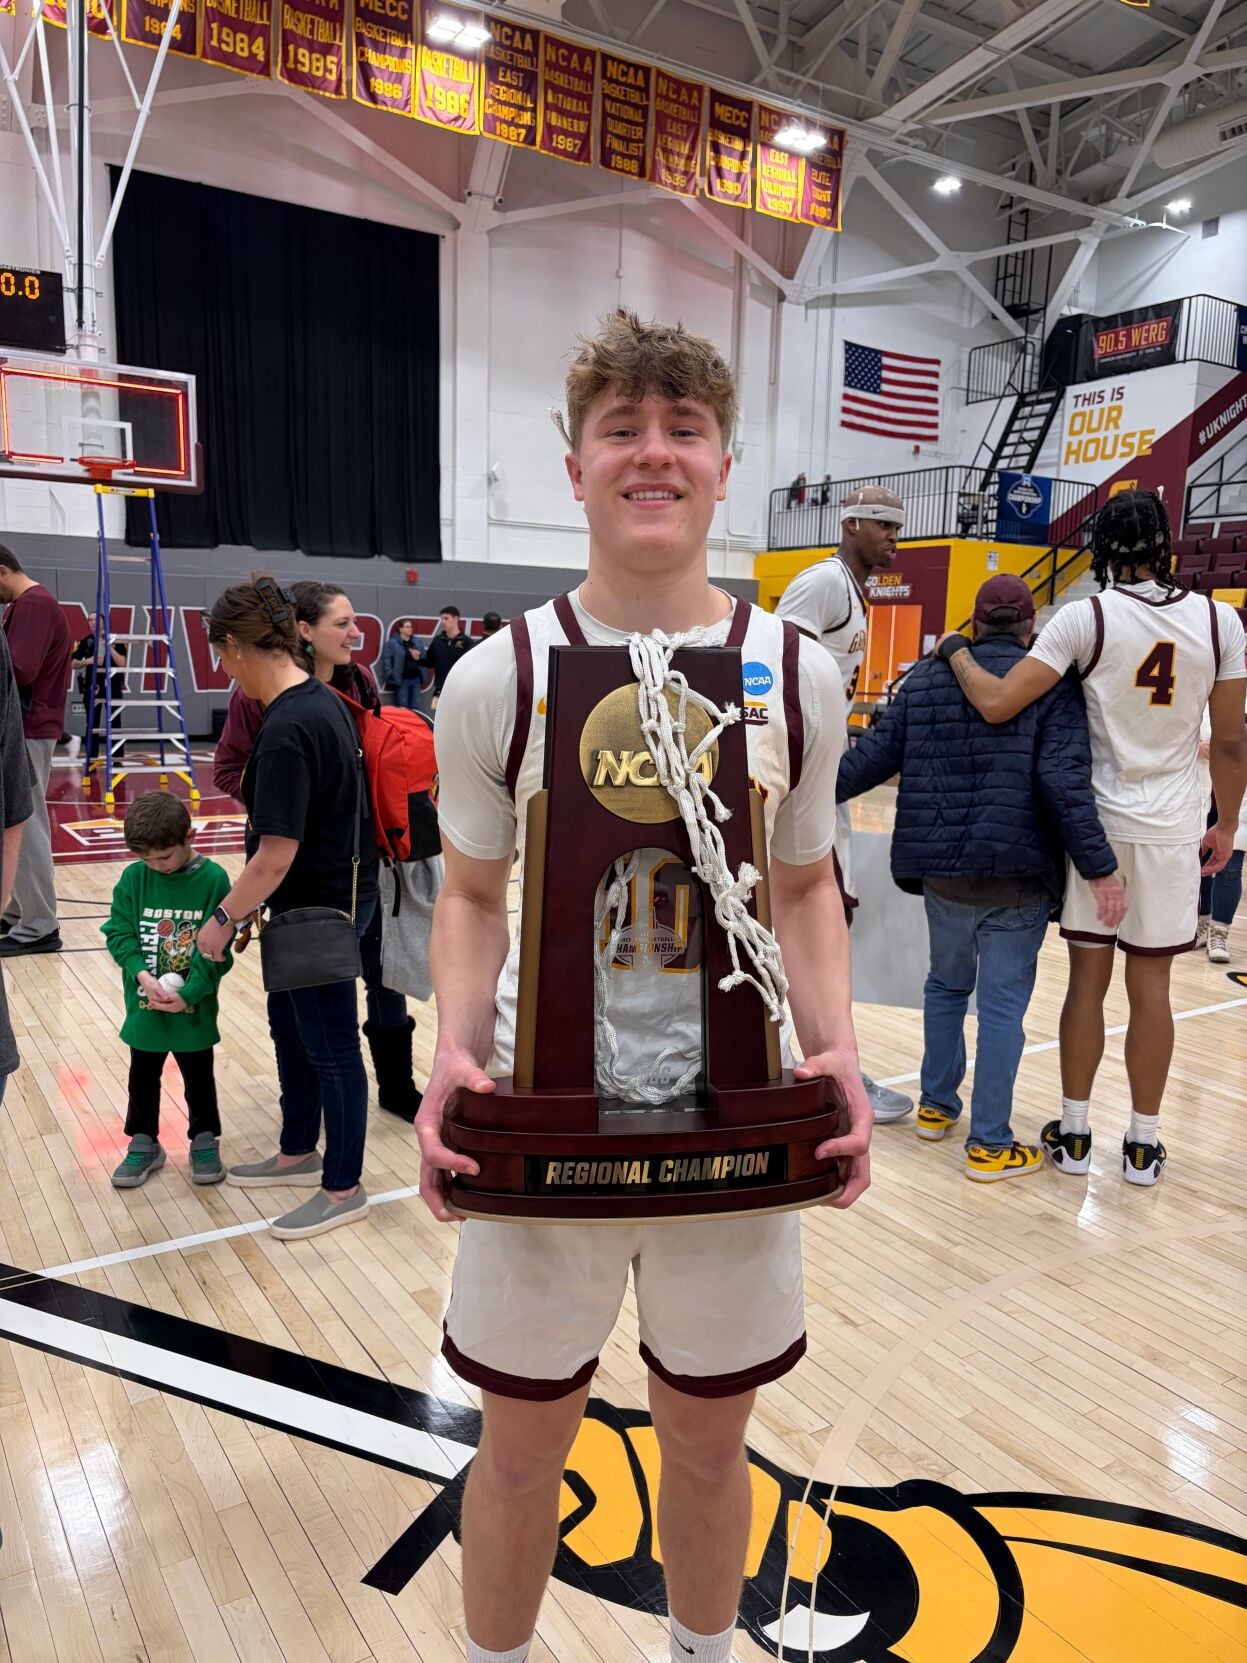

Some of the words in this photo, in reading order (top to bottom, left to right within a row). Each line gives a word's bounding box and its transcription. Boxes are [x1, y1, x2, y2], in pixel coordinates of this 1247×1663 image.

[283, 4, 343, 46] BASKETBALL
[355, 17, 415, 49] BASKETBALL
[489, 21, 534, 52] NCAA
[210, 22, 265, 62] 1984
[286, 43, 338, 82] 1985
[545, 42, 593, 75] NCAA
[606, 59, 646, 88] NCAA
[369, 76, 403, 99] 1986
[498, 67, 525, 87] EAST
[657, 76, 700, 107] NCAA
[425, 83, 470, 119] 1986
[714, 101, 750, 128] MECC
[495, 121, 527, 142] 1987
[552, 133, 582, 154] 1987
[666, 119, 688, 137] EAST
[1, 272, 40, 299] 0.0
[1097, 330, 1127, 354] 90.5
[1131, 322, 1167, 347] WERG
[1073, 389, 1105, 409] THIS
[1110, 386, 1125, 402] IS
[1068, 405, 1123, 437] OUR
[1063, 429, 1156, 466] HOUSE
[864, 574, 902, 588] GOLDEN
[869, 585, 911, 598] KNIGHTS
[744, 676, 771, 687] NCAA
[1134, 641, 1176, 706] 4
[593, 750, 713, 787] NCA
[143, 907, 204, 920] BOSTON
[546, 1161, 652, 1185] REGIONAL
[658, 1151, 770, 1182] CHAMPION
